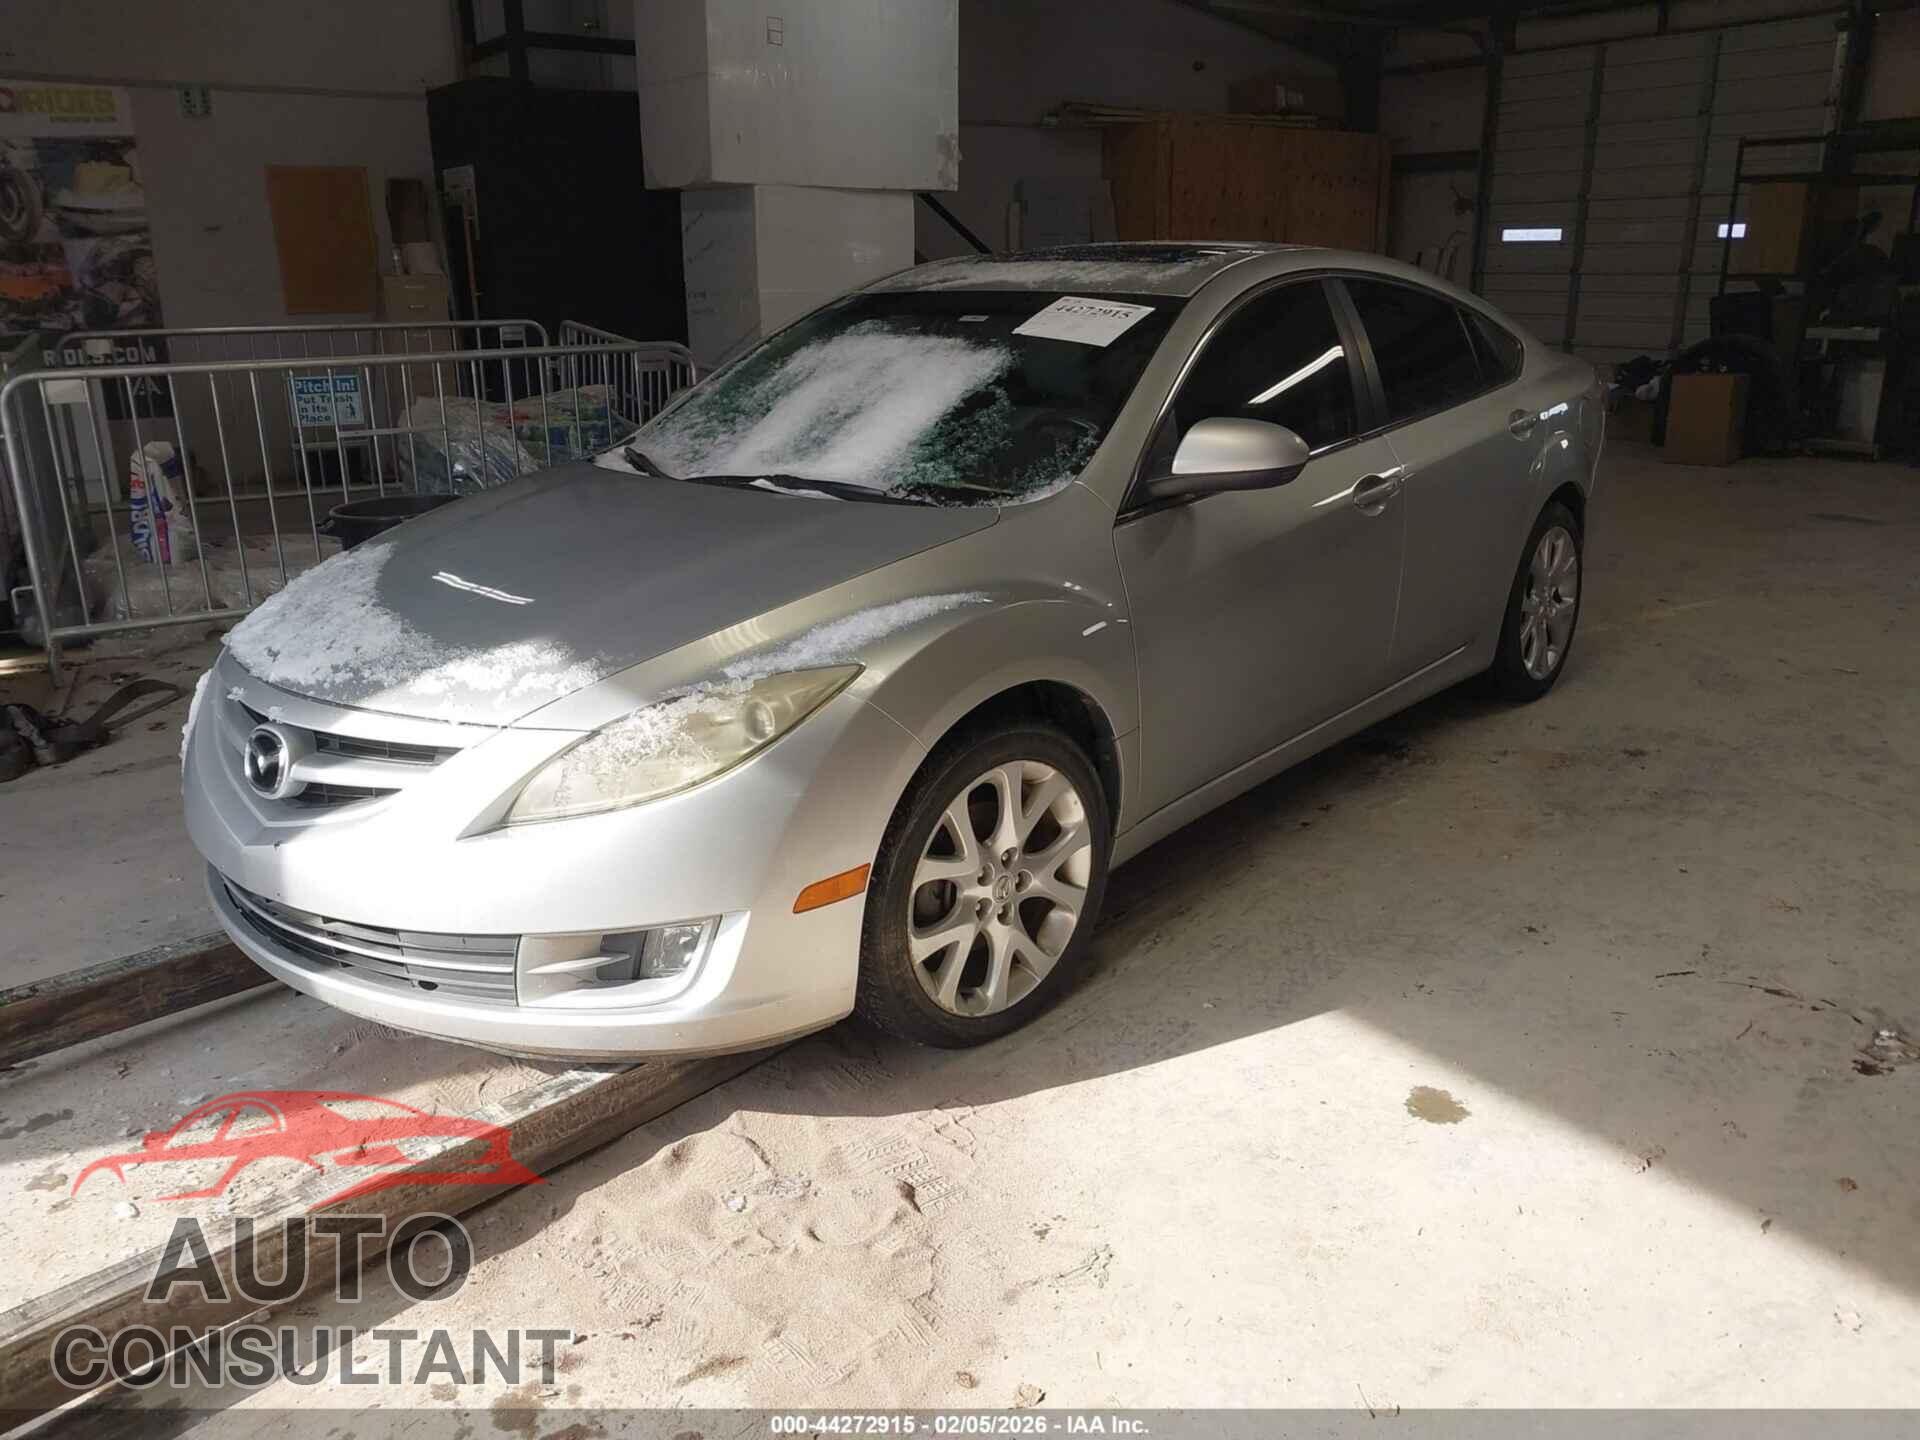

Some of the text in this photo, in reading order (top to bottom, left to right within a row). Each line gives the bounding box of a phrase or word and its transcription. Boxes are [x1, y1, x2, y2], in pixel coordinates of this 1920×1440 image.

[1056, 304, 1133, 319] 44272915
[295, 379, 356, 393] Pitch In!
[296, 394, 316, 404] Put
